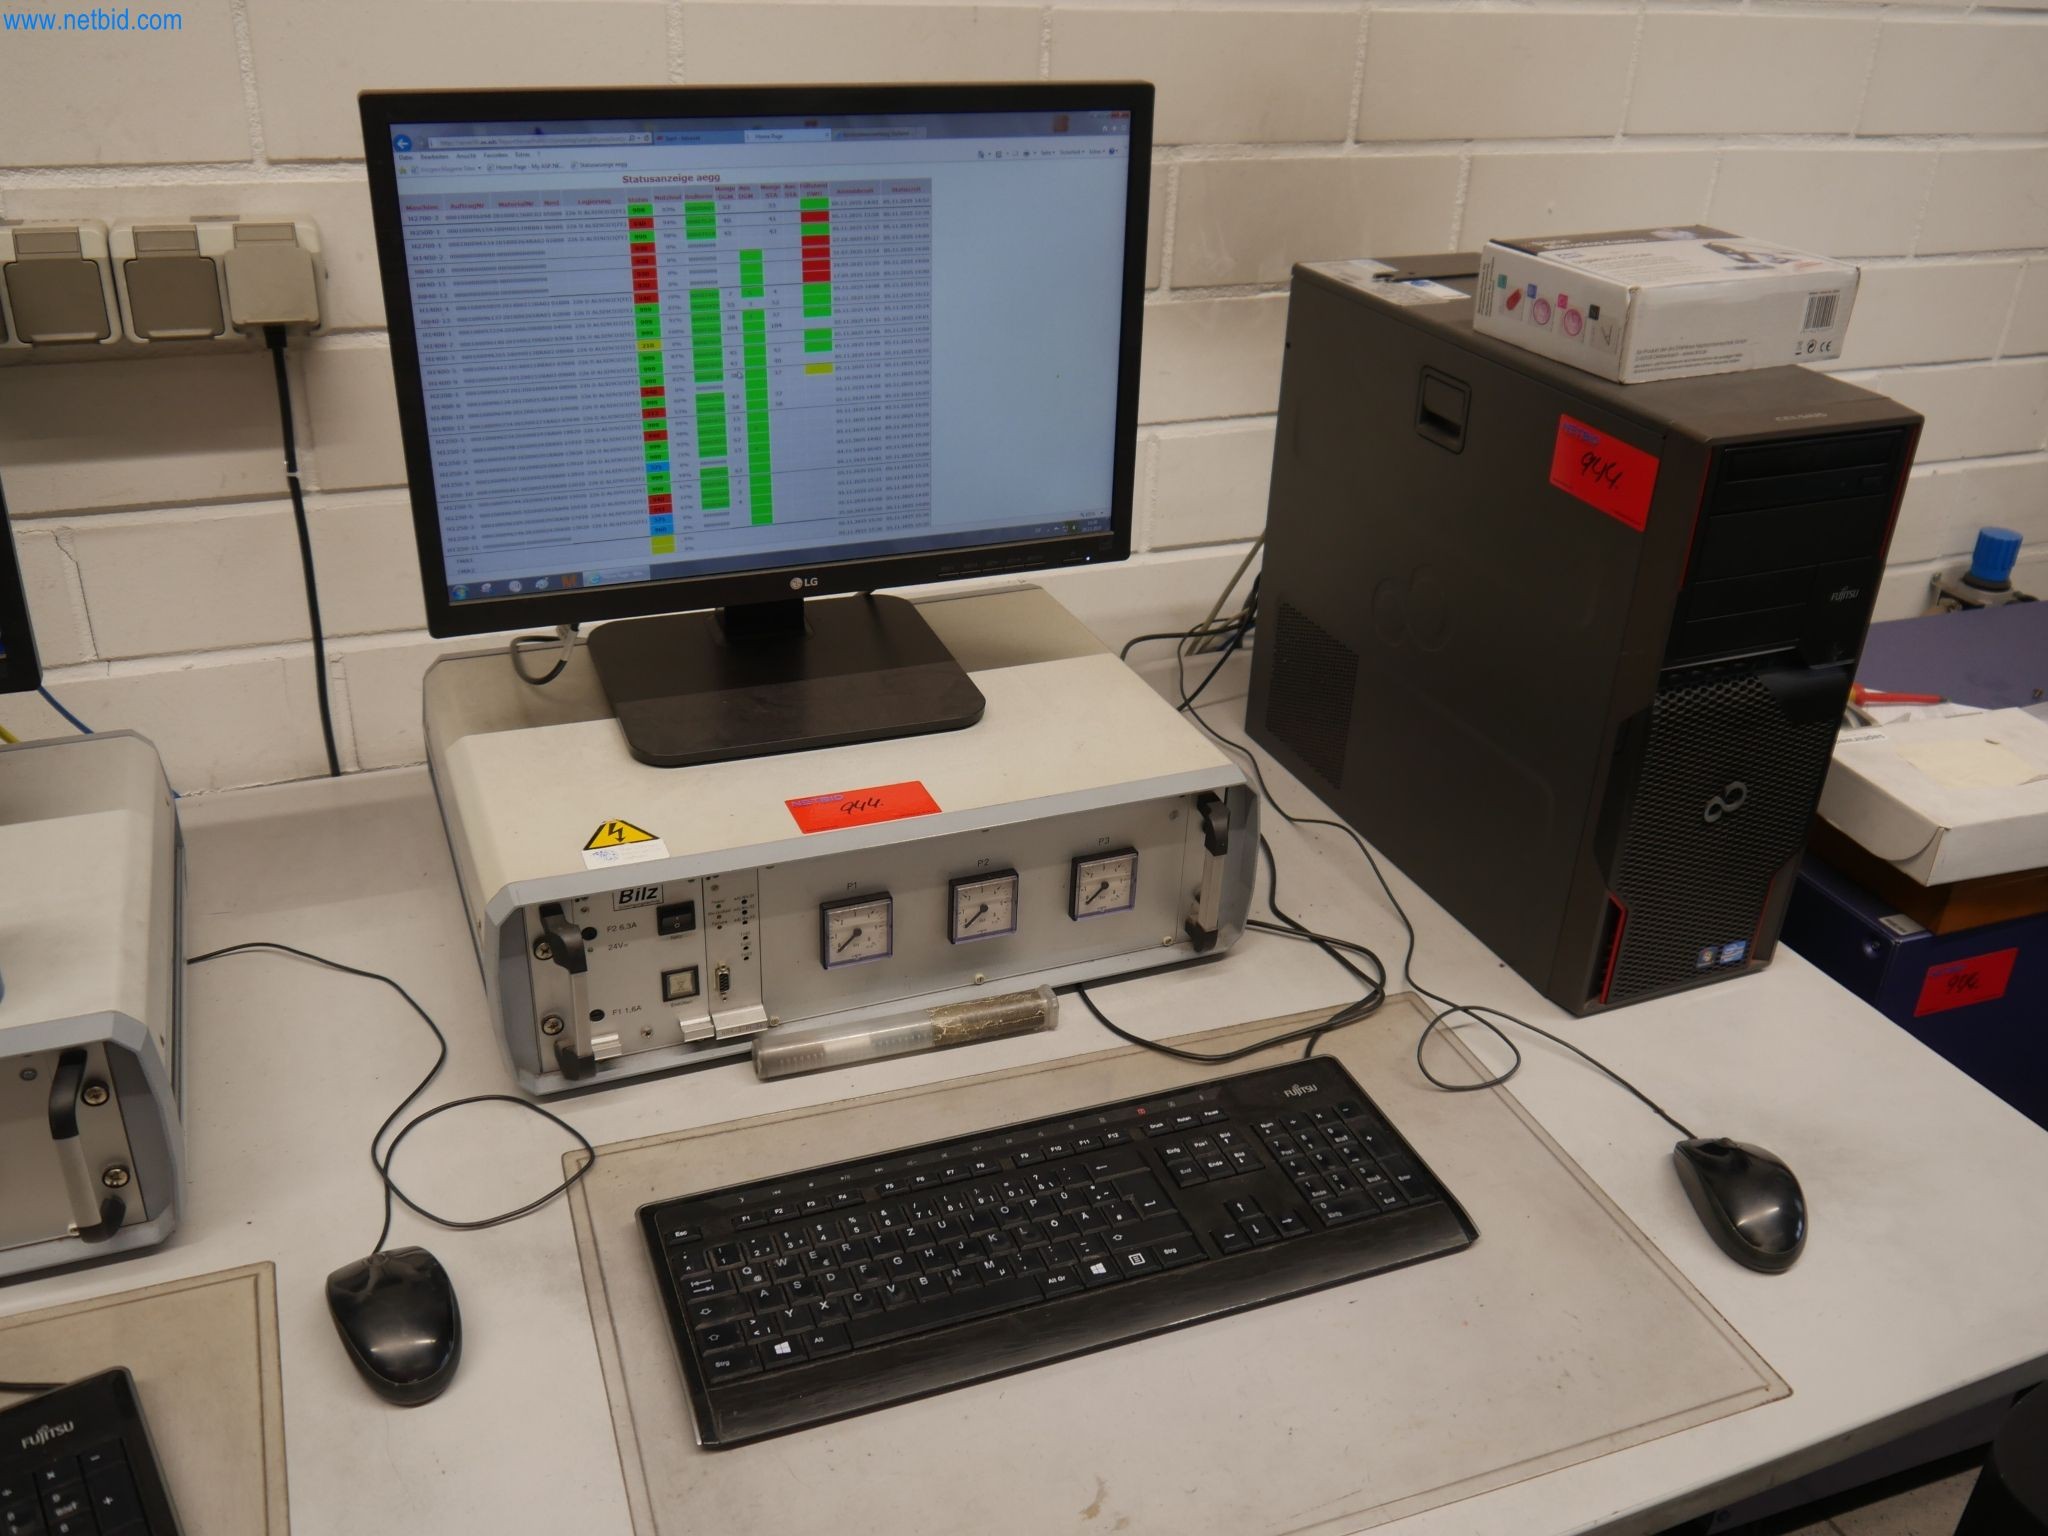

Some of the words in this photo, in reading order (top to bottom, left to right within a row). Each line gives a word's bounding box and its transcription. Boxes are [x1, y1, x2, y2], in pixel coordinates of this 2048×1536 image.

[622, 173, 693, 185] Statusanzeige
[697, 173, 720, 183] aegg
[805, 578, 818, 587] LG
[1831, 586, 1859, 600] FUJITSU
[1098, 837, 1110, 846] P3
[977, 858, 989, 867] P2
[846, 882, 858, 890] P1
[619, 886, 658, 904] Bilz
[1284, 1084, 1317, 1097] FUJITSU
[1107, 1132, 1119, 1140] F12
[1079, 1138, 1090, 1146] F11
[1029, 1199, 1038, 1207] P
[1000, 1206, 1010, 1214] O
[937, 1220, 947, 1229] U
[853, 1226, 860, 1234] 5
[907, 1228, 916, 1236] Z
[1019, 1227, 1028, 1235] L
[874, 1236, 882, 1244] T
[988, 1234, 998, 1242] K
[841, 1243, 851, 1252] R
[958, 1241, 964, 1250] J
[809, 1251, 817, 1259] E
[924, 1249, 935, 1258] H
[1164, 1248, 1178, 1256] Strg
[776, 1258, 787, 1267] W
[893, 1257, 903, 1265] G
[984, 1260, 995, 1269] M
[742, 1267, 752, 1275] Q
[859, 1265, 867, 1273] F
[952, 1268, 962, 1278] N
[826, 1273, 836, 1281] D
[919, 1277, 928, 1286] B
[1048, 1276, 1056, 1284] Alt
[793, 1281, 802, 1289] S
[886, 1284, 896, 1293] V
[760, 1289, 769, 1298] A
[853, 1293, 863, 1302] C
[819, 1301, 829, 1310] X
[785, 1309, 794, 1317] Y
[715, 1359, 730, 1368] Strg
[21, 1420, 75, 1449] FUJITSU
